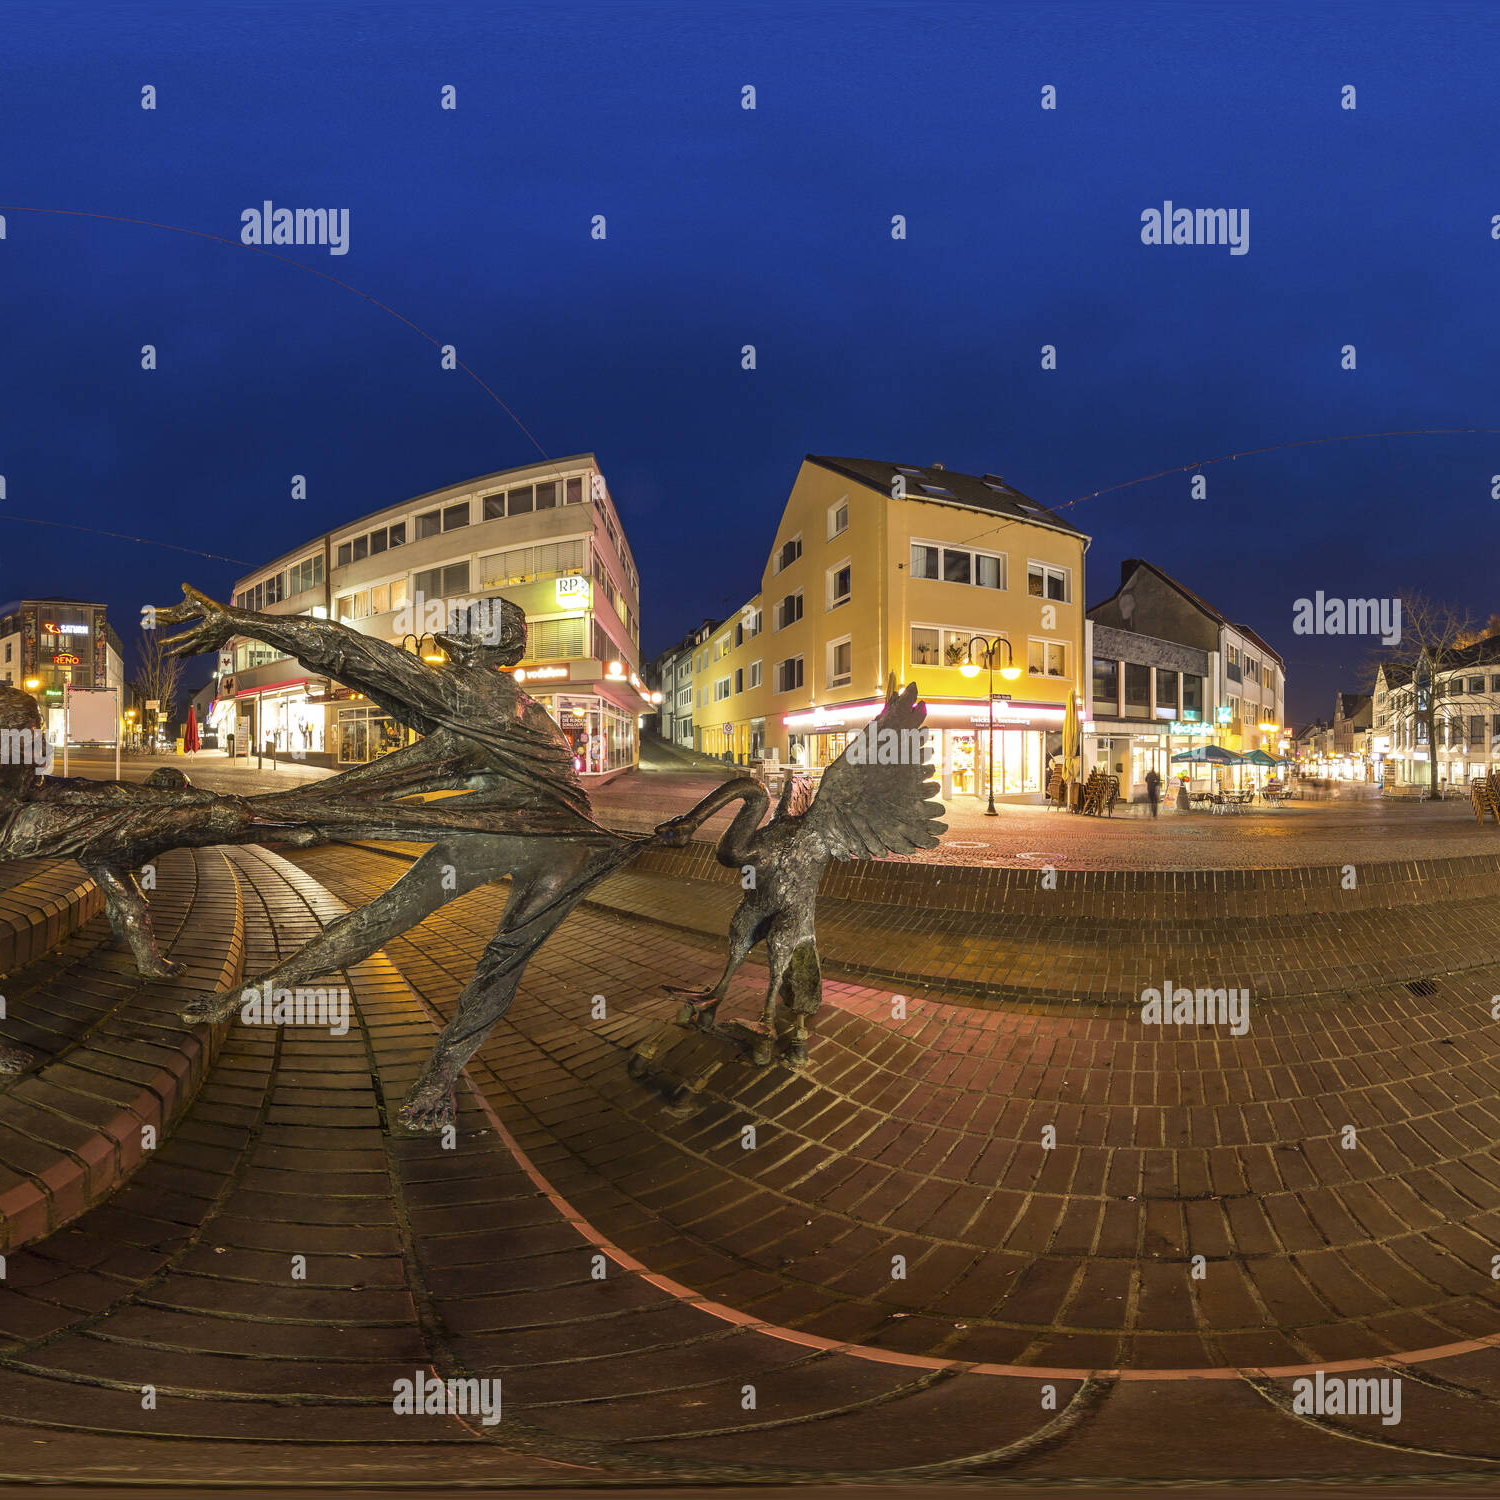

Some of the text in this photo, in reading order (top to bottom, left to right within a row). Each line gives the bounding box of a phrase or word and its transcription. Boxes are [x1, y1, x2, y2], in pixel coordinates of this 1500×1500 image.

[559, 578, 578, 592] RP
[60, 624, 89, 634] SATURN
[53, 655, 80, 665] RENO
[526, 667, 568, 680] vodafone
